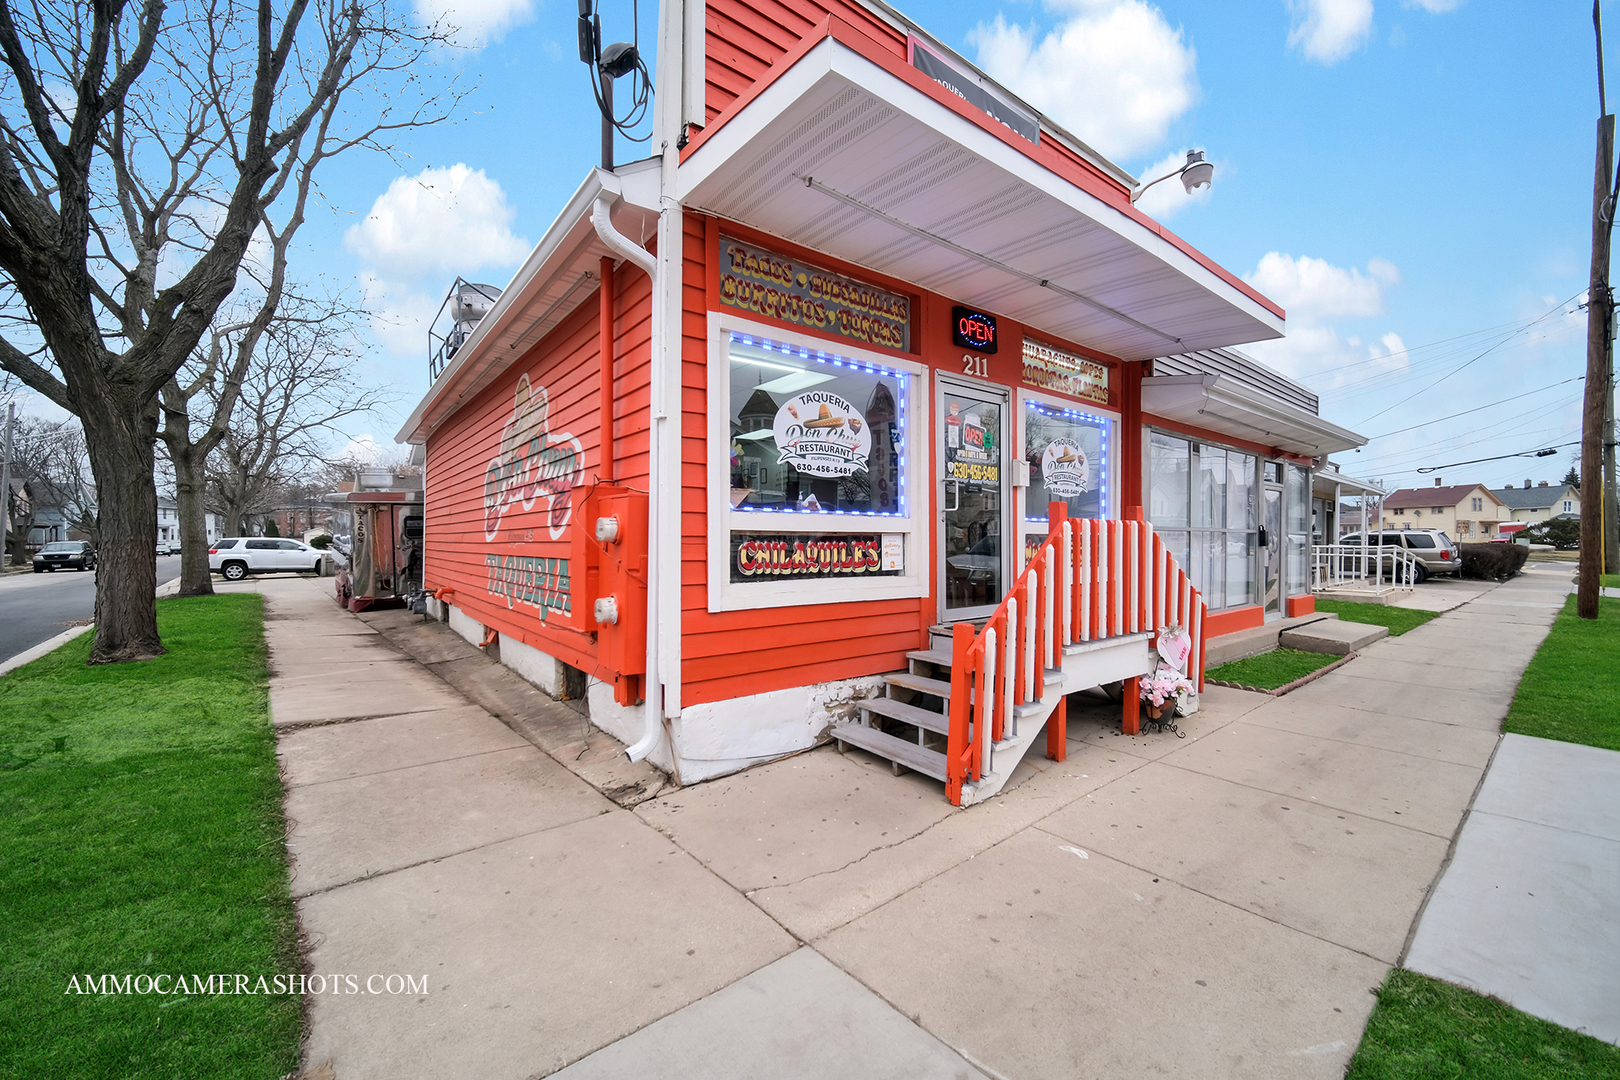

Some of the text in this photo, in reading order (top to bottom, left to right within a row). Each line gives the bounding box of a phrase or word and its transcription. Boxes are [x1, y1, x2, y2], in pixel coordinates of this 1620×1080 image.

[727, 245, 908, 325] TACOS QUESADILLAS
[720, 273, 904, 349] BURRITOS TORTAS
[959, 317, 994, 343] OPEN
[962, 354, 989, 378] 211
[1080, 361, 1105, 382] SOPES
[799, 393, 850, 414] TAQUERIA
[785, 424, 822, 447] Don
[965, 426, 984, 447] OPEN
[1054, 438, 1079, 451] TAQUERIA
[799, 443, 851, 458] RESTAURANT
[796, 463, 851, 475] 630-456-5481
[1053, 474, 1080, 483] RESTAURANT
[357, 514, 365, 543] TACOS
[737, 540, 881, 576] CHILAQUILES
[484, 554, 571, 627] TAQUERIA
